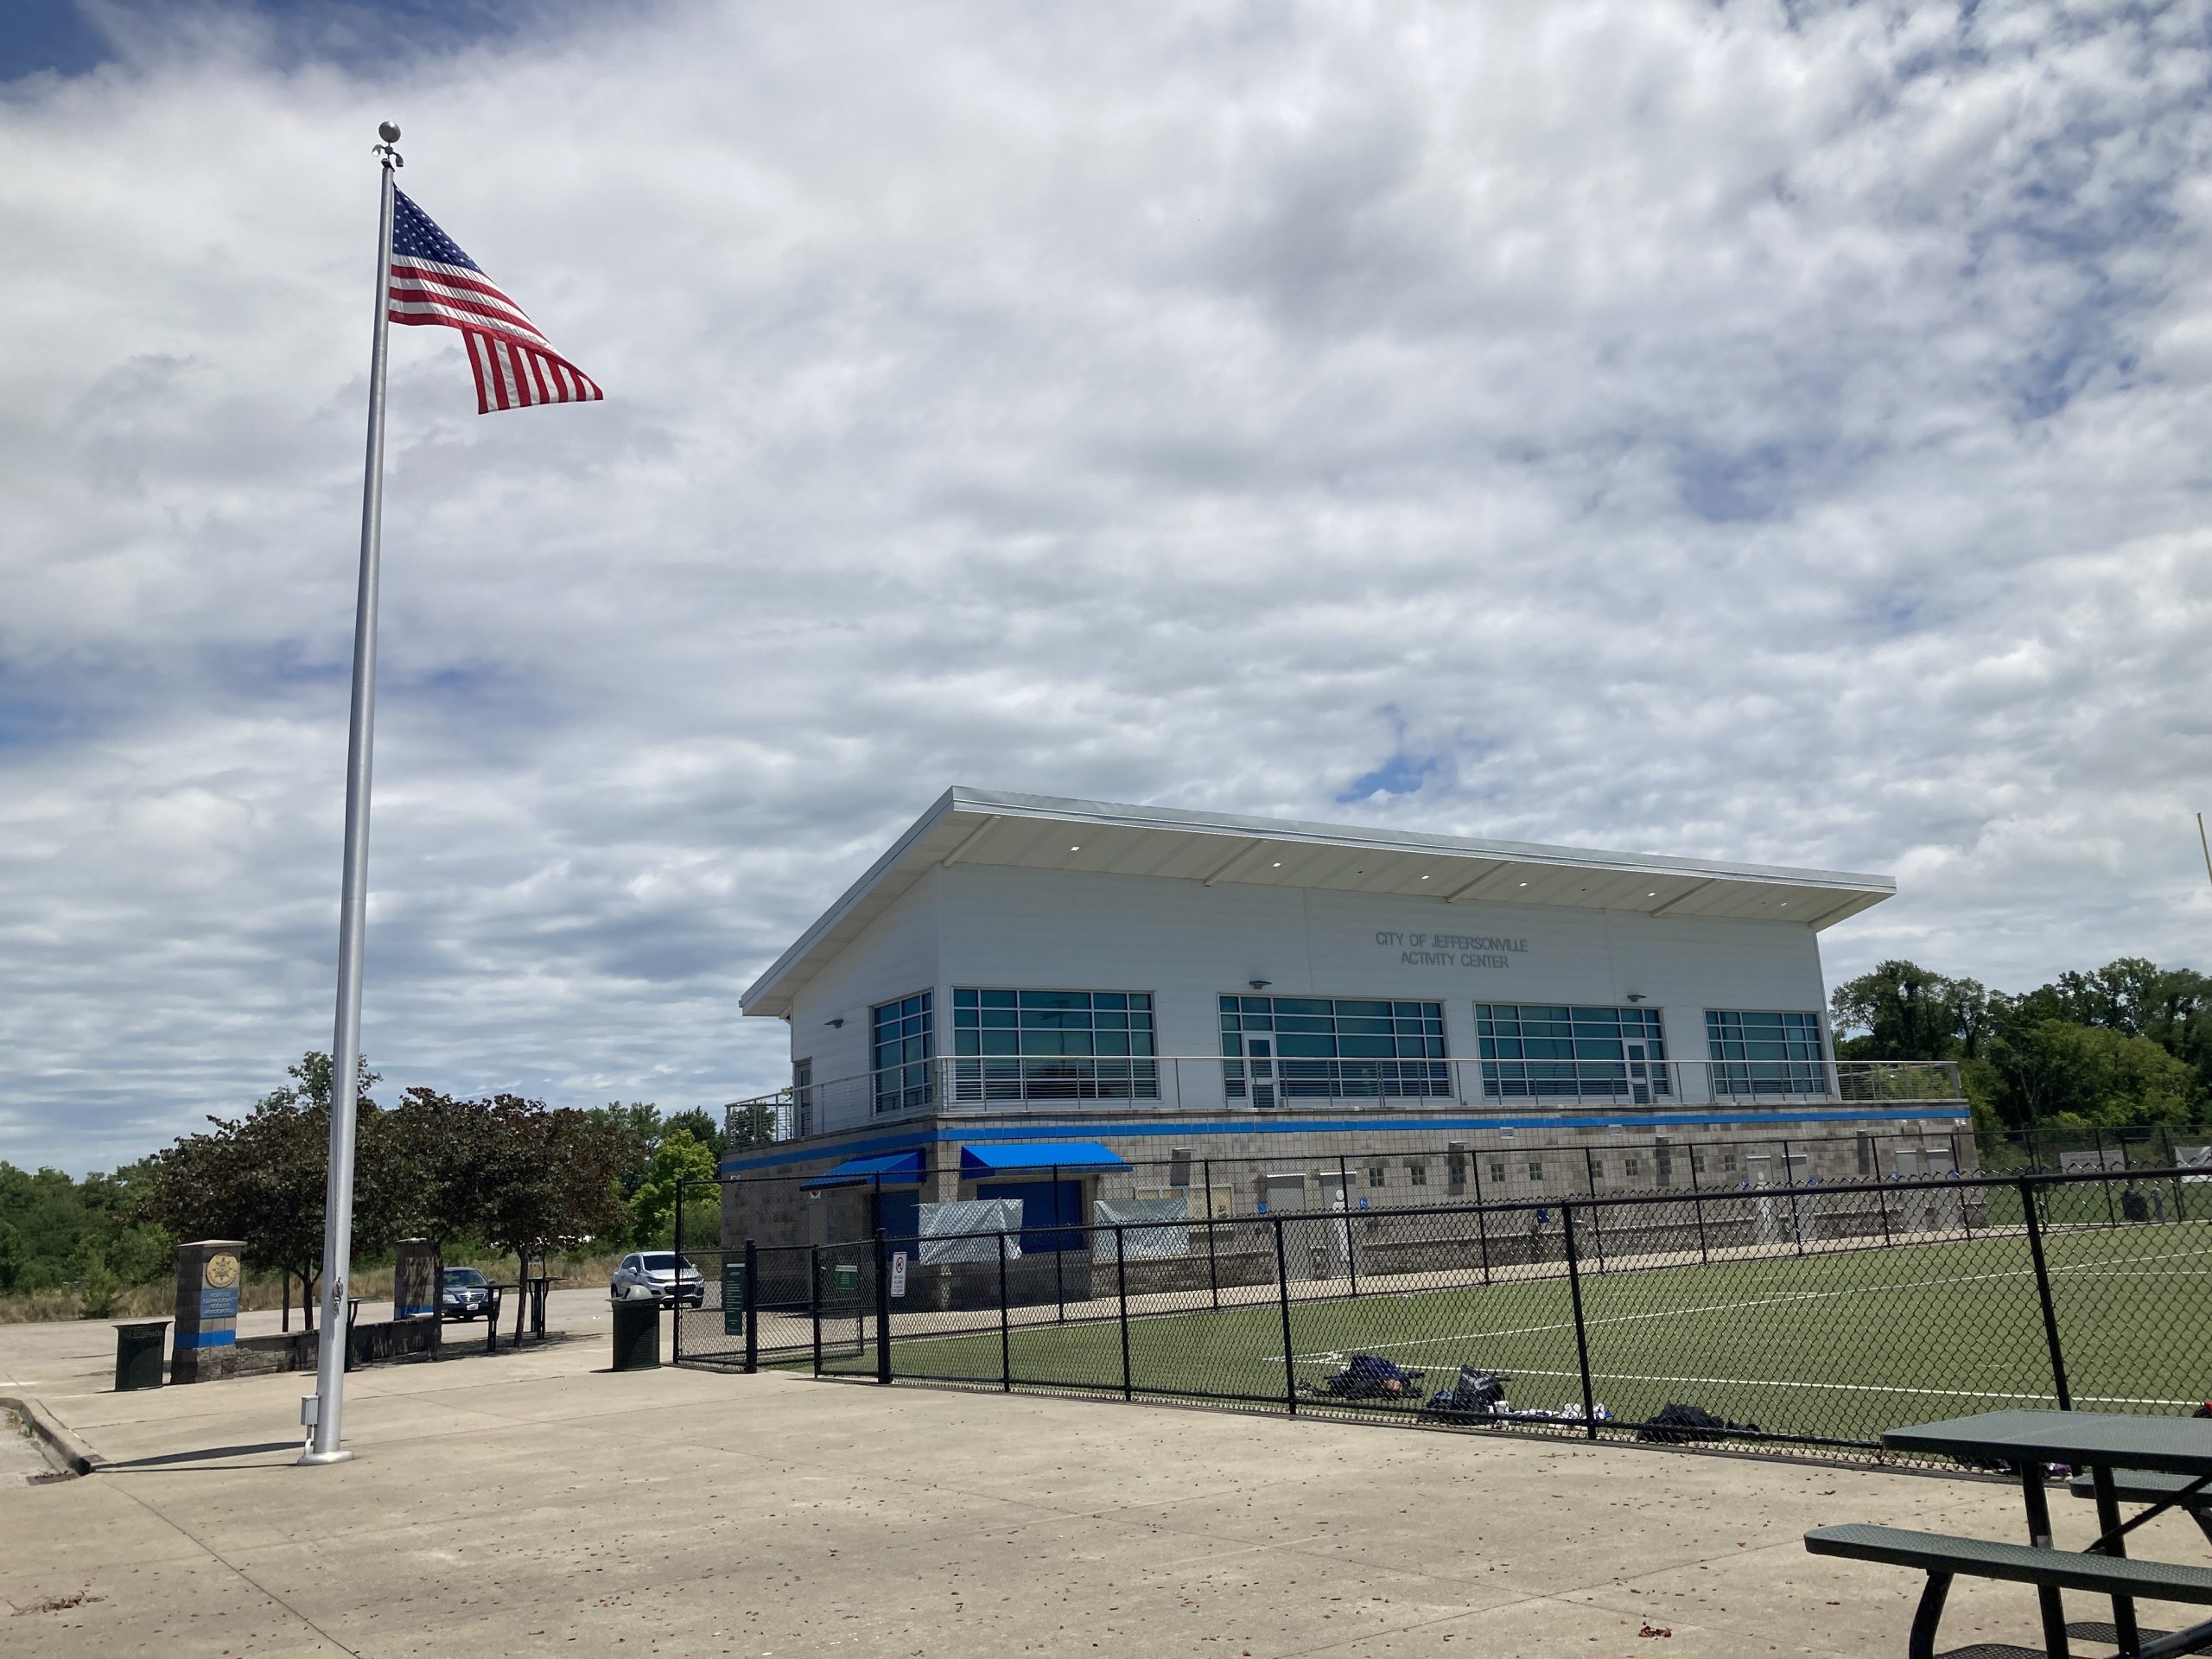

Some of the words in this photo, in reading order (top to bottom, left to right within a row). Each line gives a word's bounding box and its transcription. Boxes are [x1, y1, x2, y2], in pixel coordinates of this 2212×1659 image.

[1376, 931, 1404, 946] CITY
[1409, 933, 1427, 948] OF
[1432, 935, 1528, 953] JEFFERSONVILLE
[1402, 952, 1455, 966] ACTIVITY
[1461, 955, 1509, 969] CENTER
